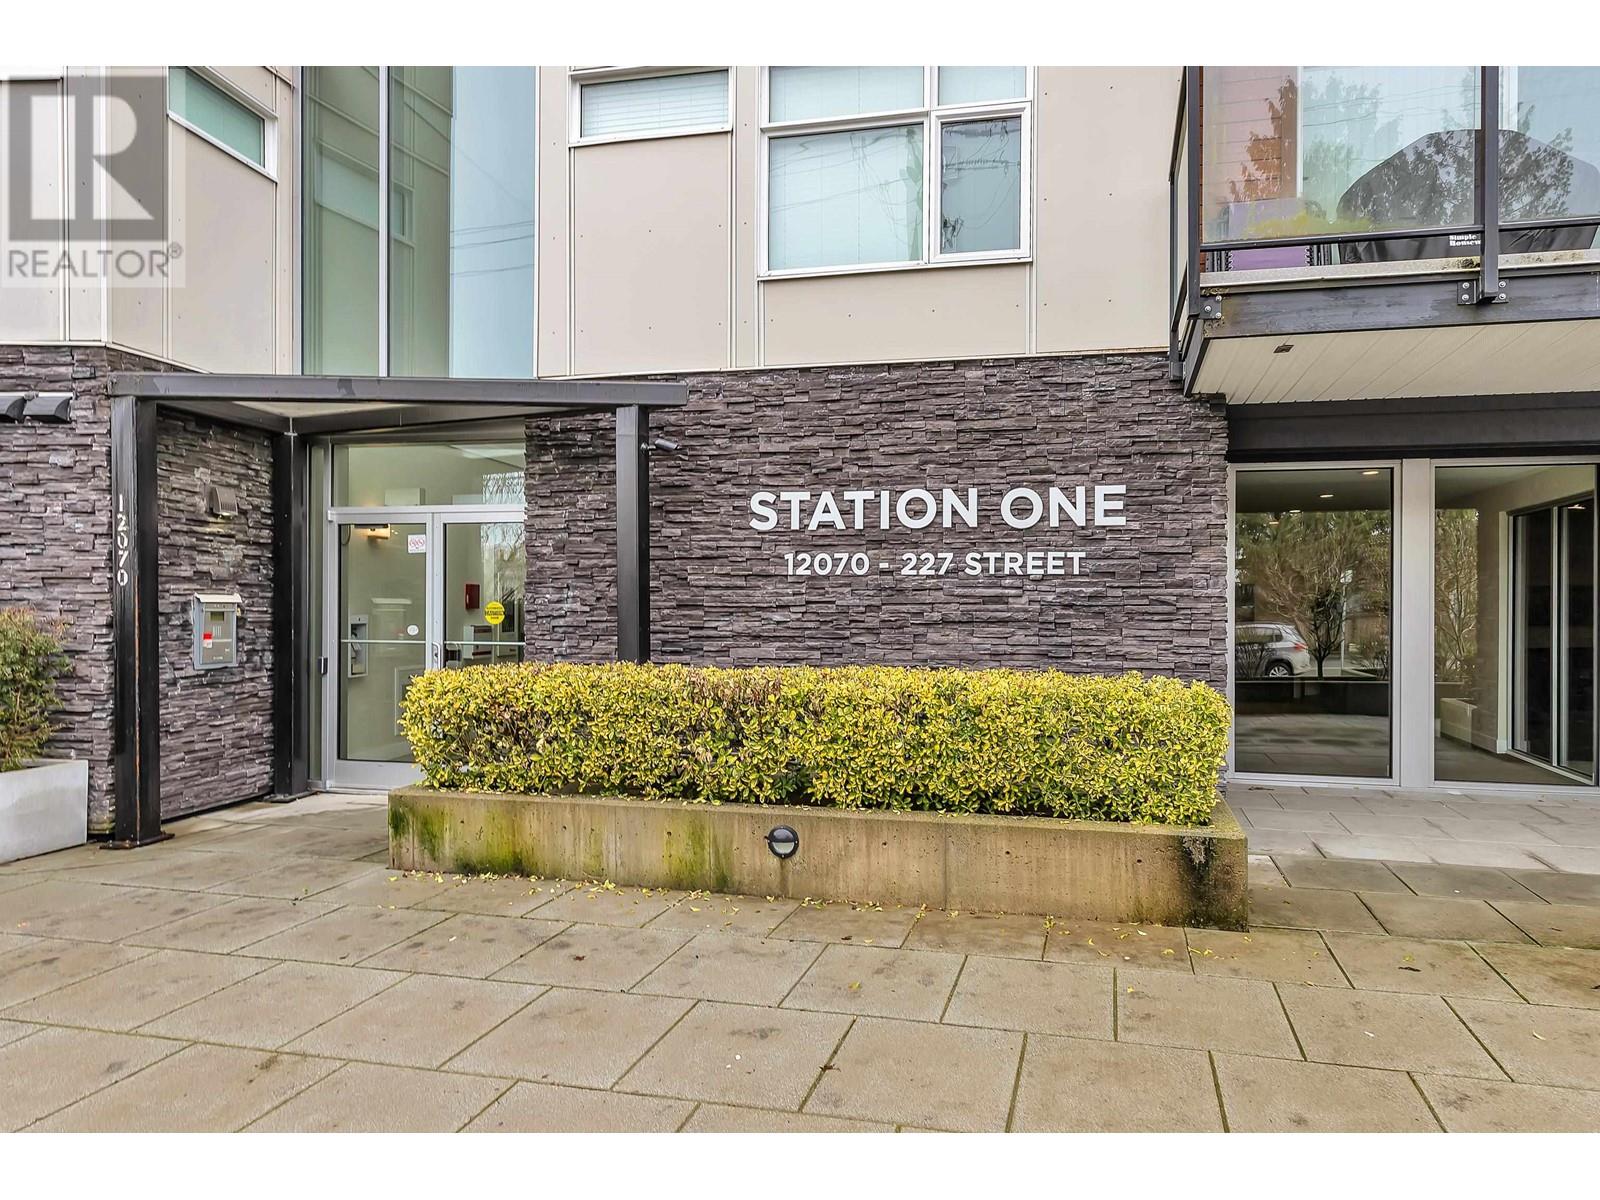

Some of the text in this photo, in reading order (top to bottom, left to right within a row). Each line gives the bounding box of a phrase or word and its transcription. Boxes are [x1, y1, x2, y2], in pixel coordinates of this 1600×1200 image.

[749, 484, 1127, 531] STATION ONE
[117, 494, 129, 586] 12070
[784, 552, 870, 576] 12070
[901, 551, 954, 576] 227
[964, 551, 1086, 576] STREET
